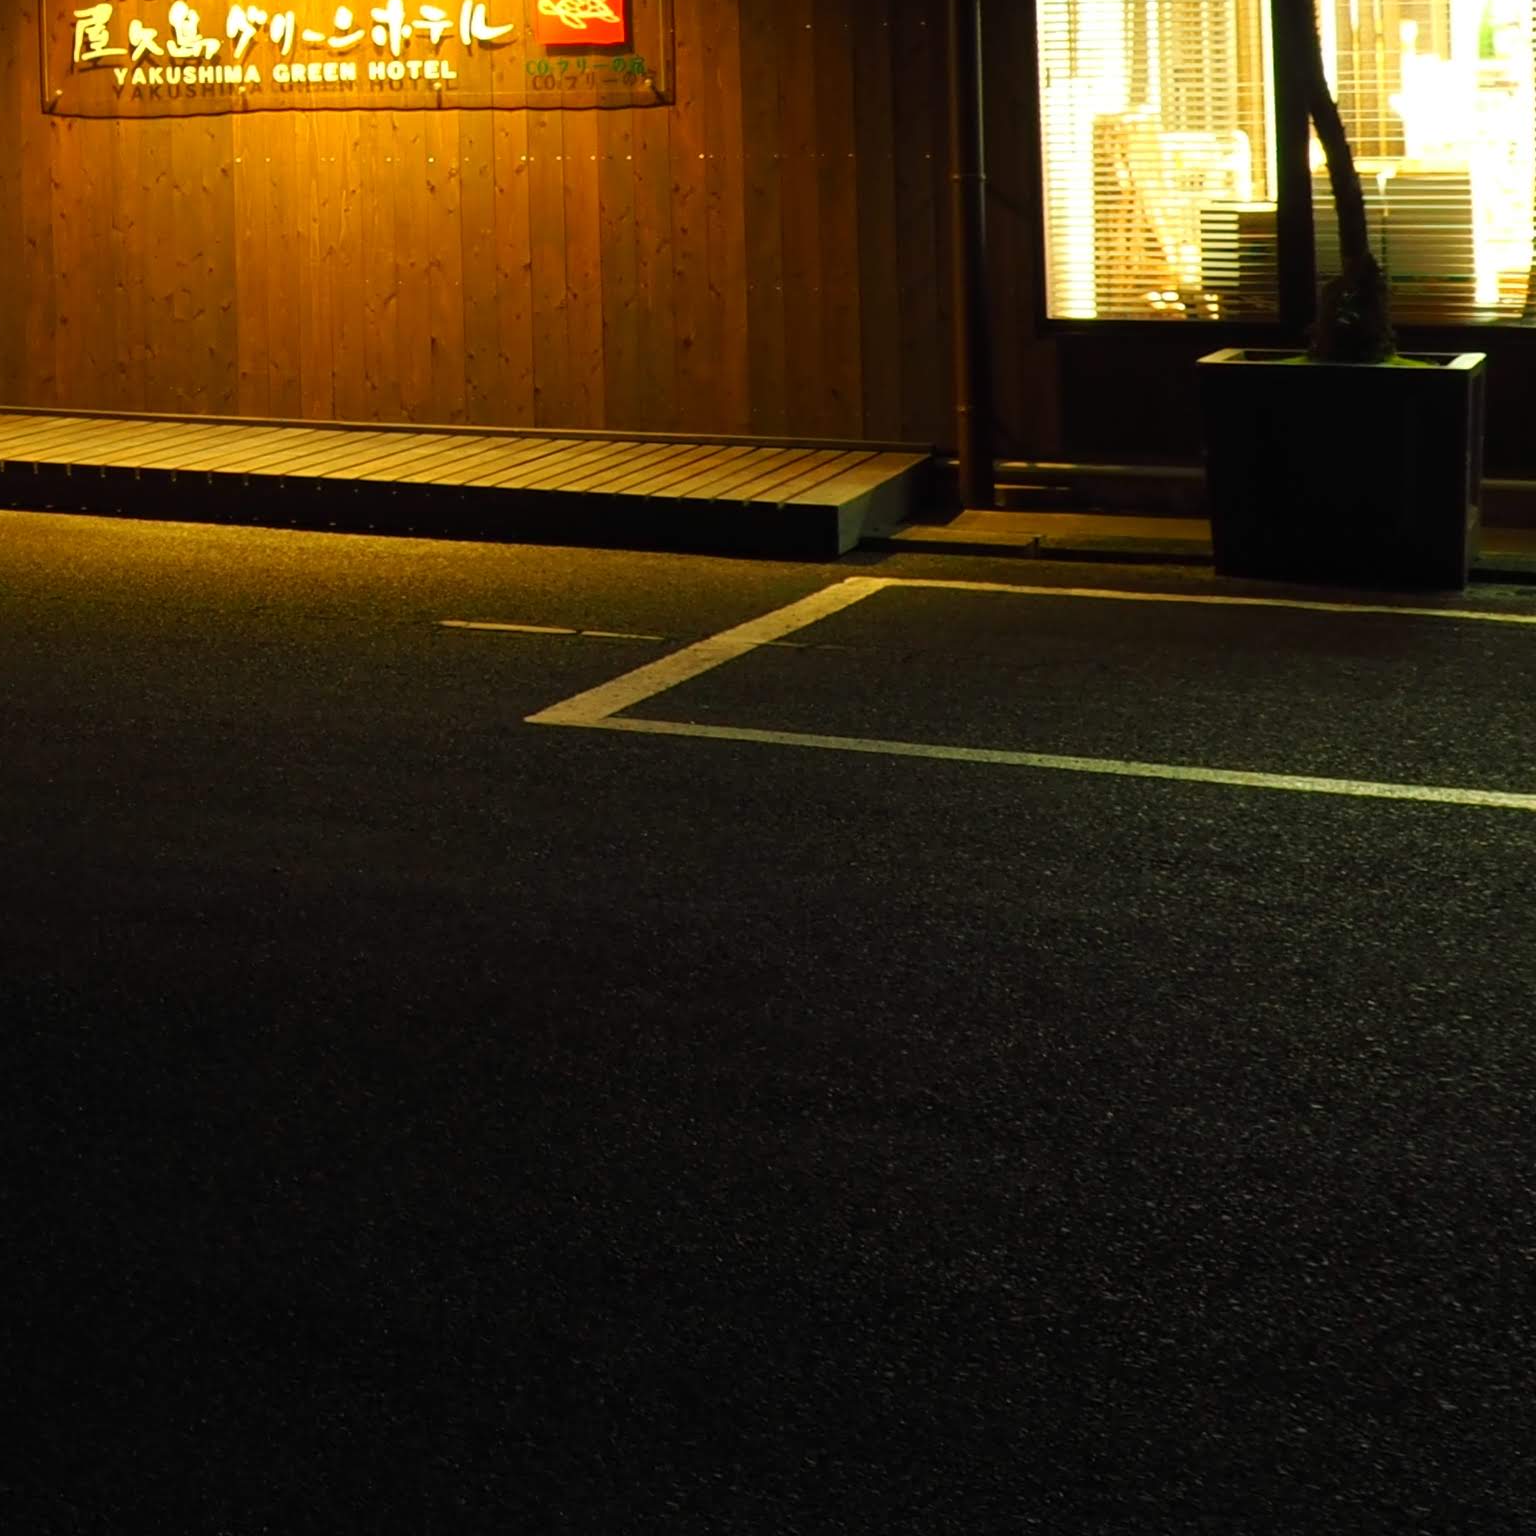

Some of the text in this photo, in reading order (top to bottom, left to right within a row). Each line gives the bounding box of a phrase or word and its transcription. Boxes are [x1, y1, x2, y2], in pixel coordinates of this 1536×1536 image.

[113, 60, 457, 85] YAKUSHIMA GREEN HOTEL
